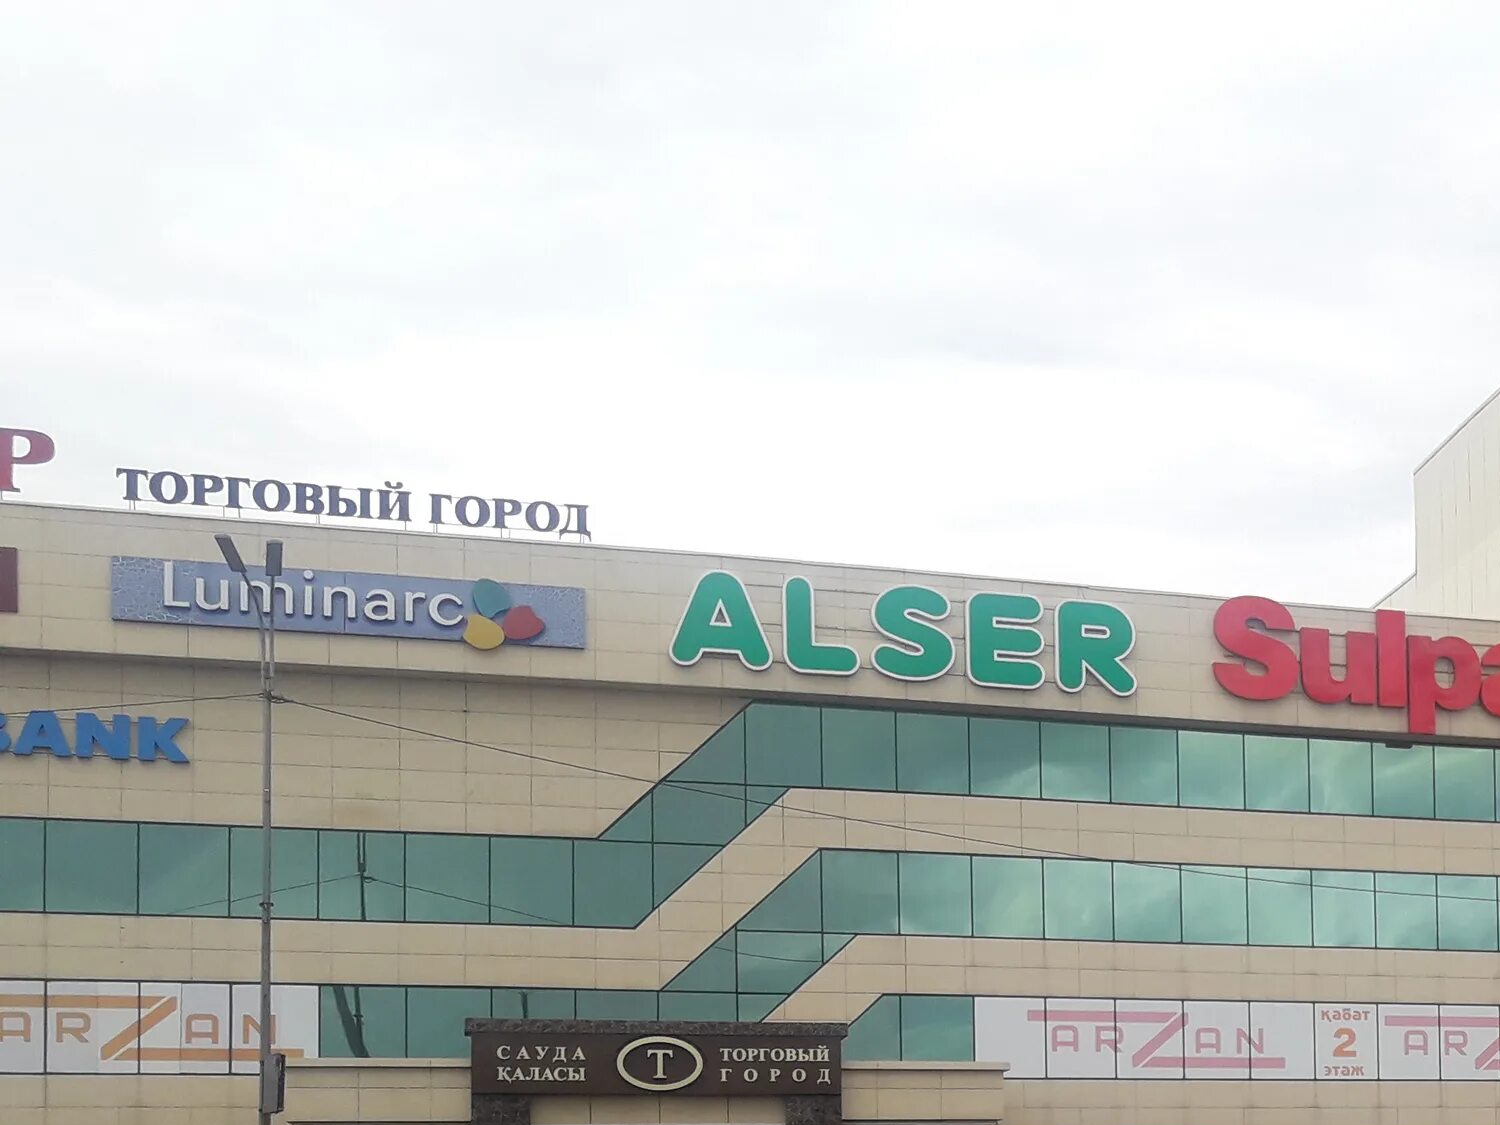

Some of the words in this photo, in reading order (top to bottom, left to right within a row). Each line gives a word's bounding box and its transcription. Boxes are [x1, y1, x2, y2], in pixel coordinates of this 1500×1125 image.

[116, 467, 412, 522] ТОРГОВЫЙ
[429, 493, 592, 541] ГОРОД
[163, 560, 465, 626] Luminarc
[668, 568, 1137, 698] ALSER
[0, 710, 190, 763] ANK
[0, 994, 305, 1061] ARZAN
[1027, 1009, 1286, 1069] ARZAN
[1333, 1027, 1357, 1057] 2
[496, 1045, 587, 1062] САУДА
[719, 1044, 831, 1063] ТОРГОВЫЙ
[1323, 1066, 1364, 1077] этаж
[496, 1066, 587, 1085] ҚАЛАСЫ
[719, 1068, 832, 1085] ГОРОД
